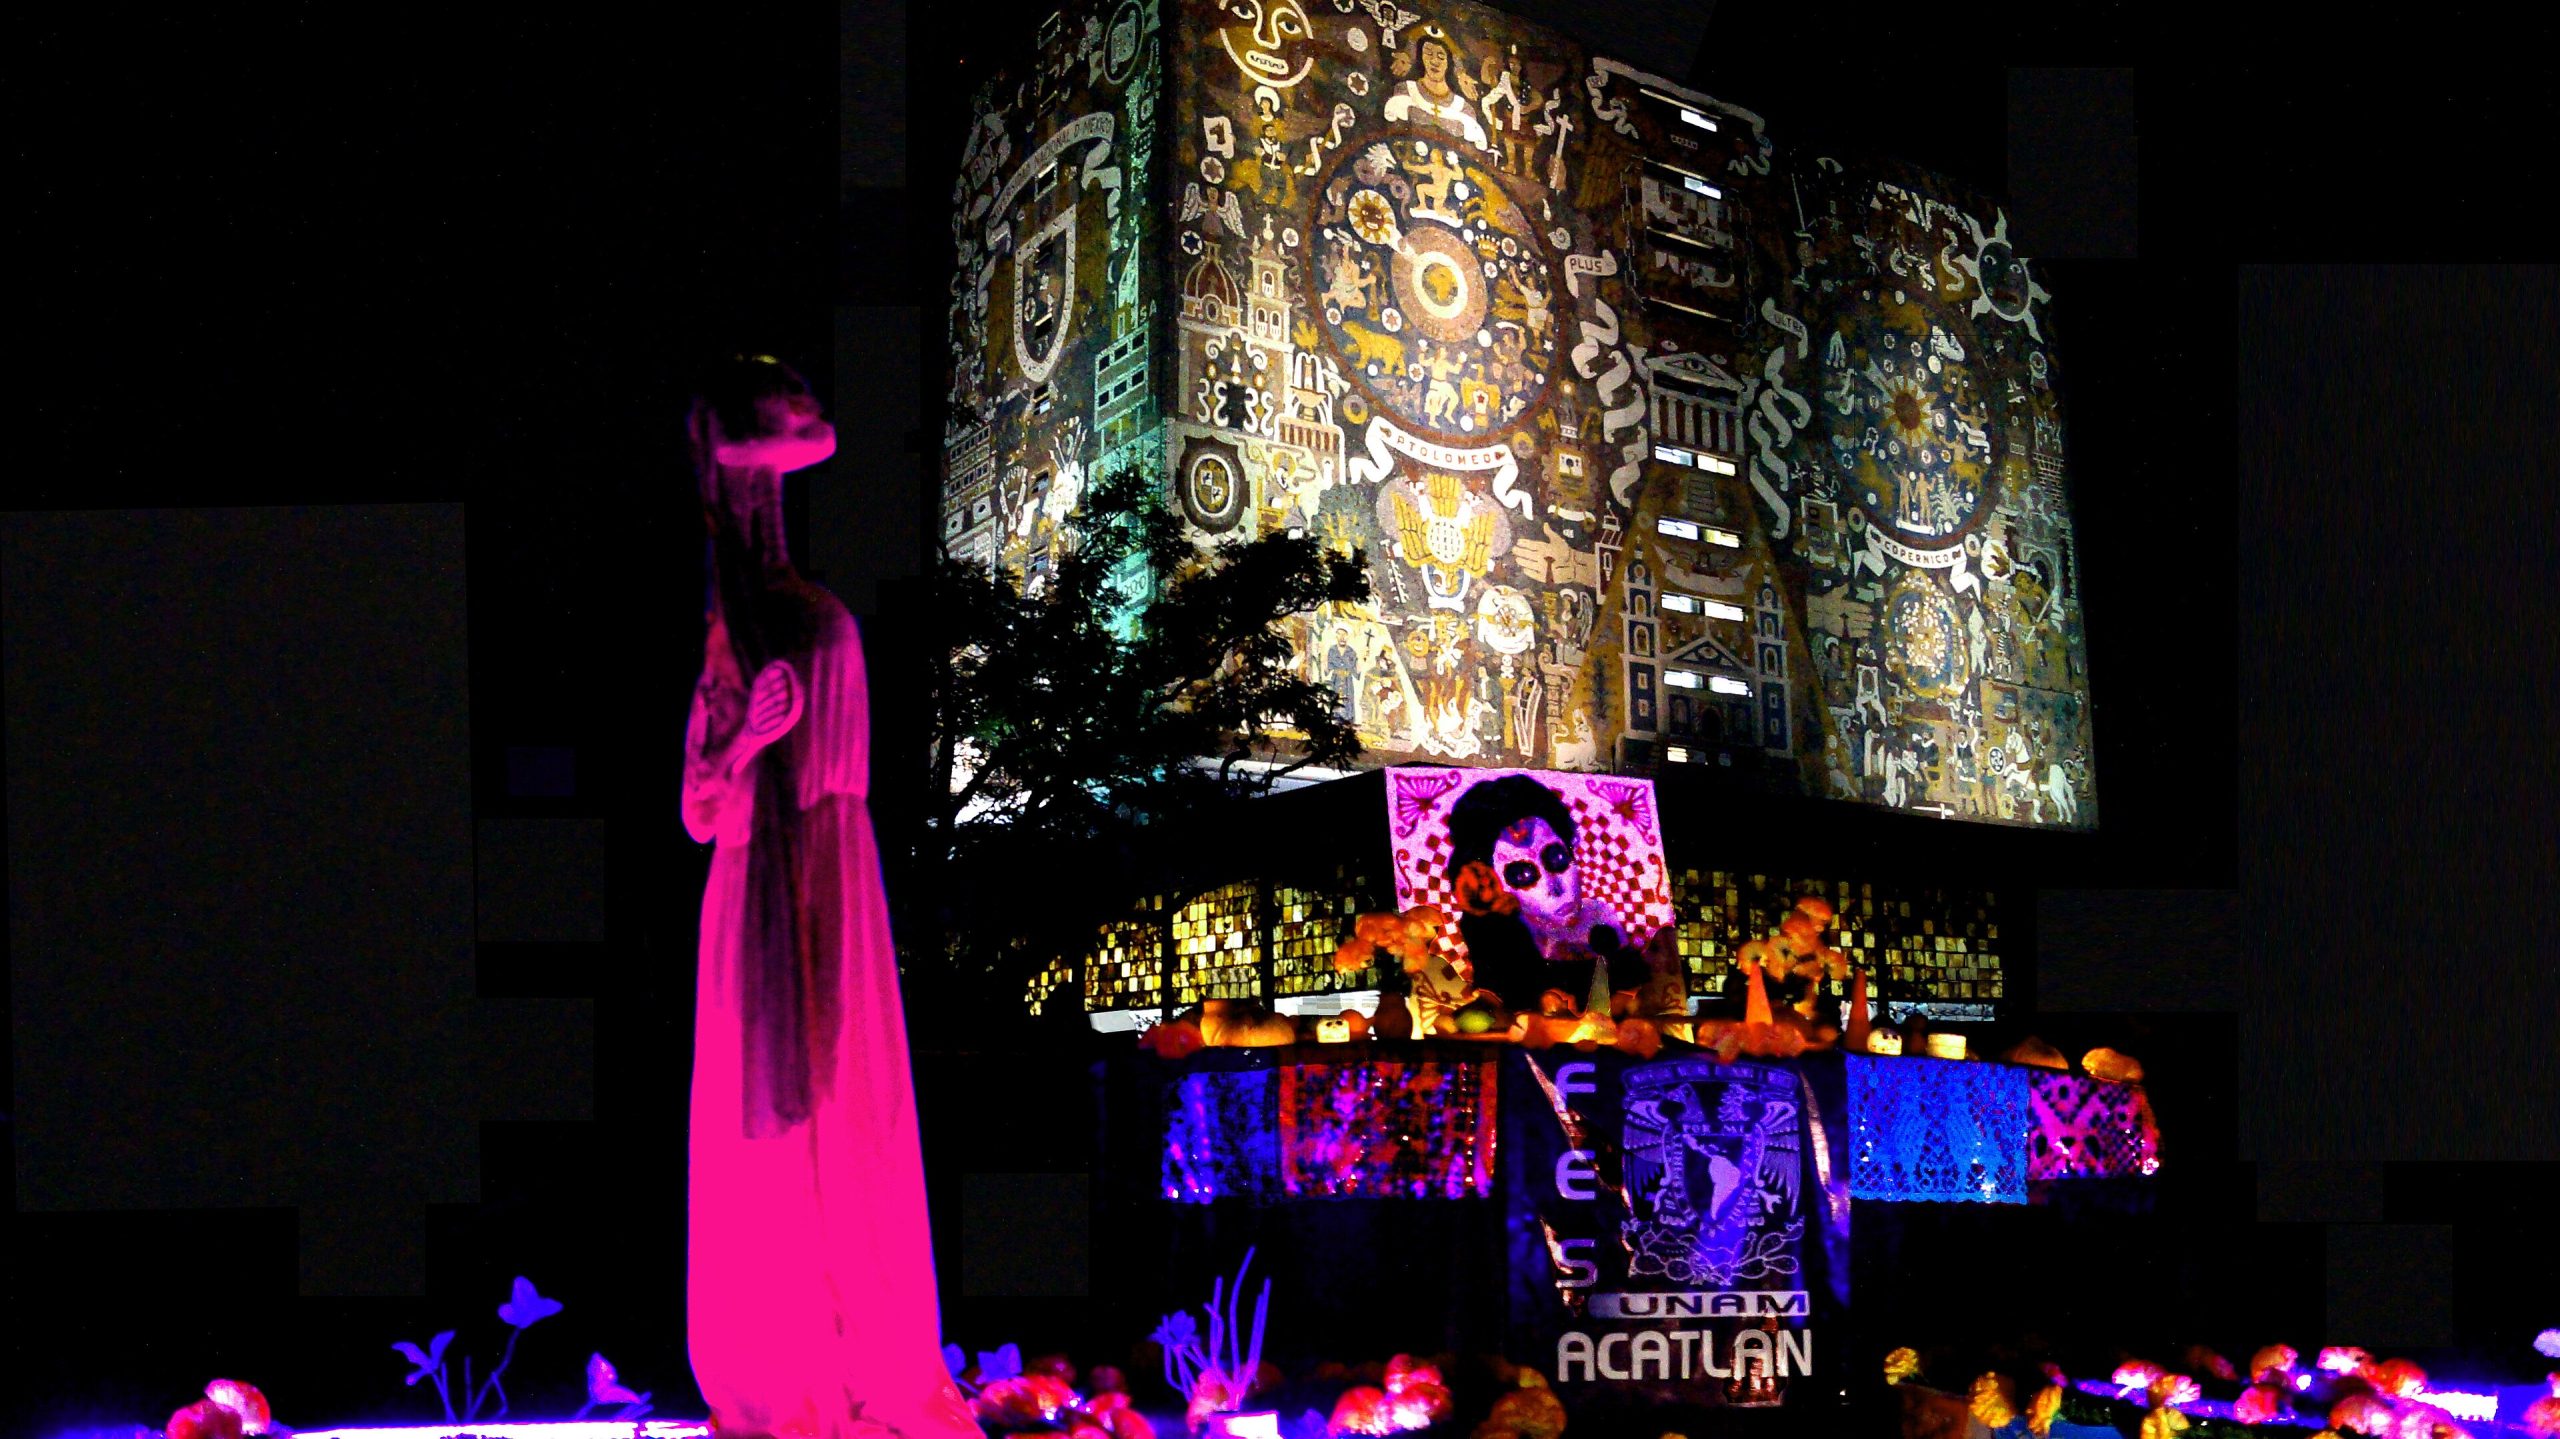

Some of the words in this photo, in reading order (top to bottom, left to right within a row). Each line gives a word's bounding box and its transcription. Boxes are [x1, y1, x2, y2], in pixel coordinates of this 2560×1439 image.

[1569, 257, 1602, 273] PLUS
[1397, 435, 1491, 465] PTOLOMEO
[1884, 542, 1949, 564] COPERNICO
[1618, 1293, 1802, 1316] UNAM
[1558, 1329, 1812, 1382] ACATLAN
